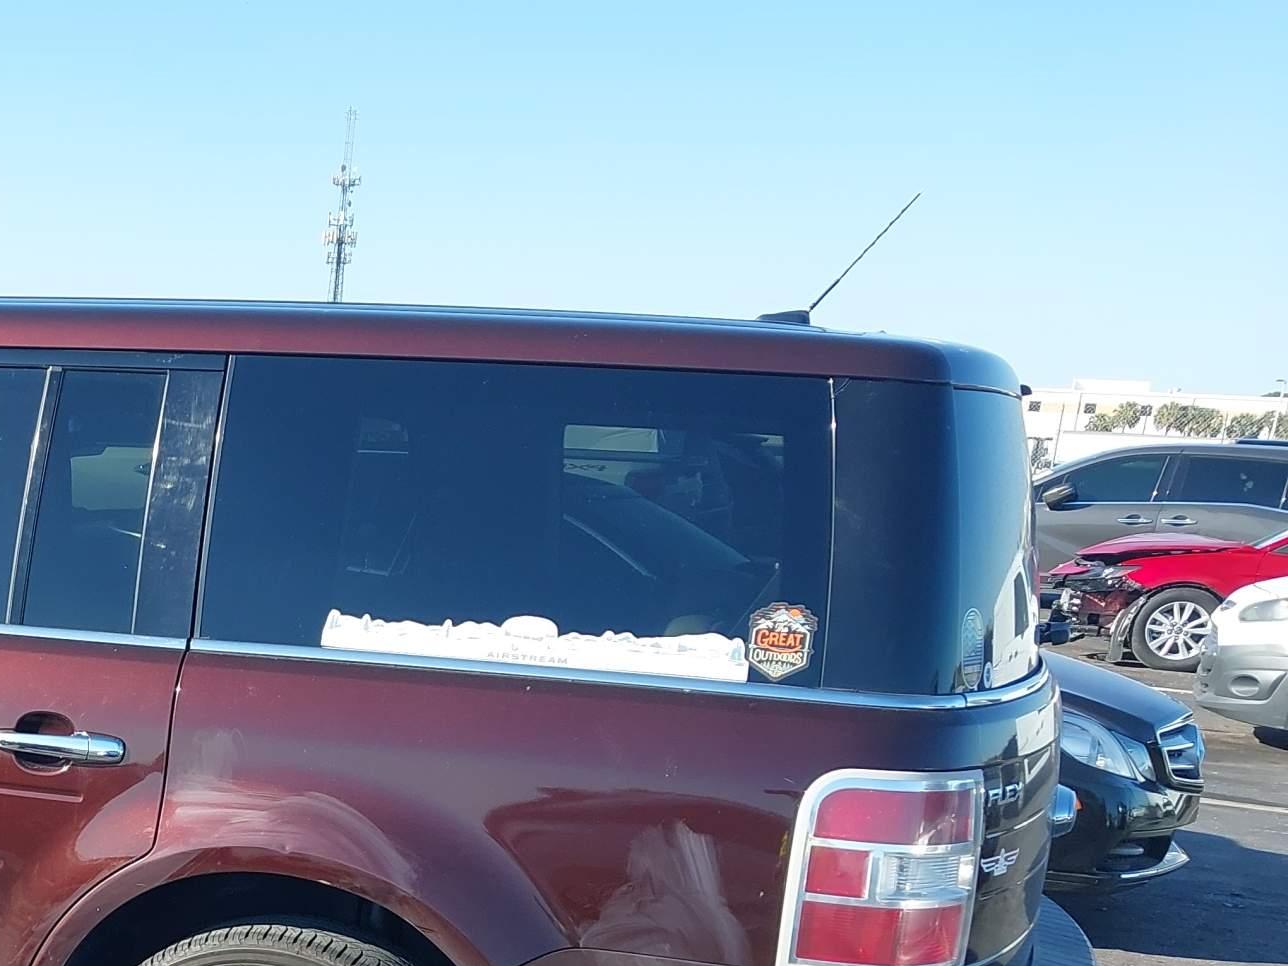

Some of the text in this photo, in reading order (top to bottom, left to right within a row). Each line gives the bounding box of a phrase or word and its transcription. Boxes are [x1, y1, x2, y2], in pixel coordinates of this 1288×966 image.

[756, 629, 804, 647] GREAT
[487, 651, 569, 665] AIRSTREAM
[753, 648, 803, 664] OUTDOORS
